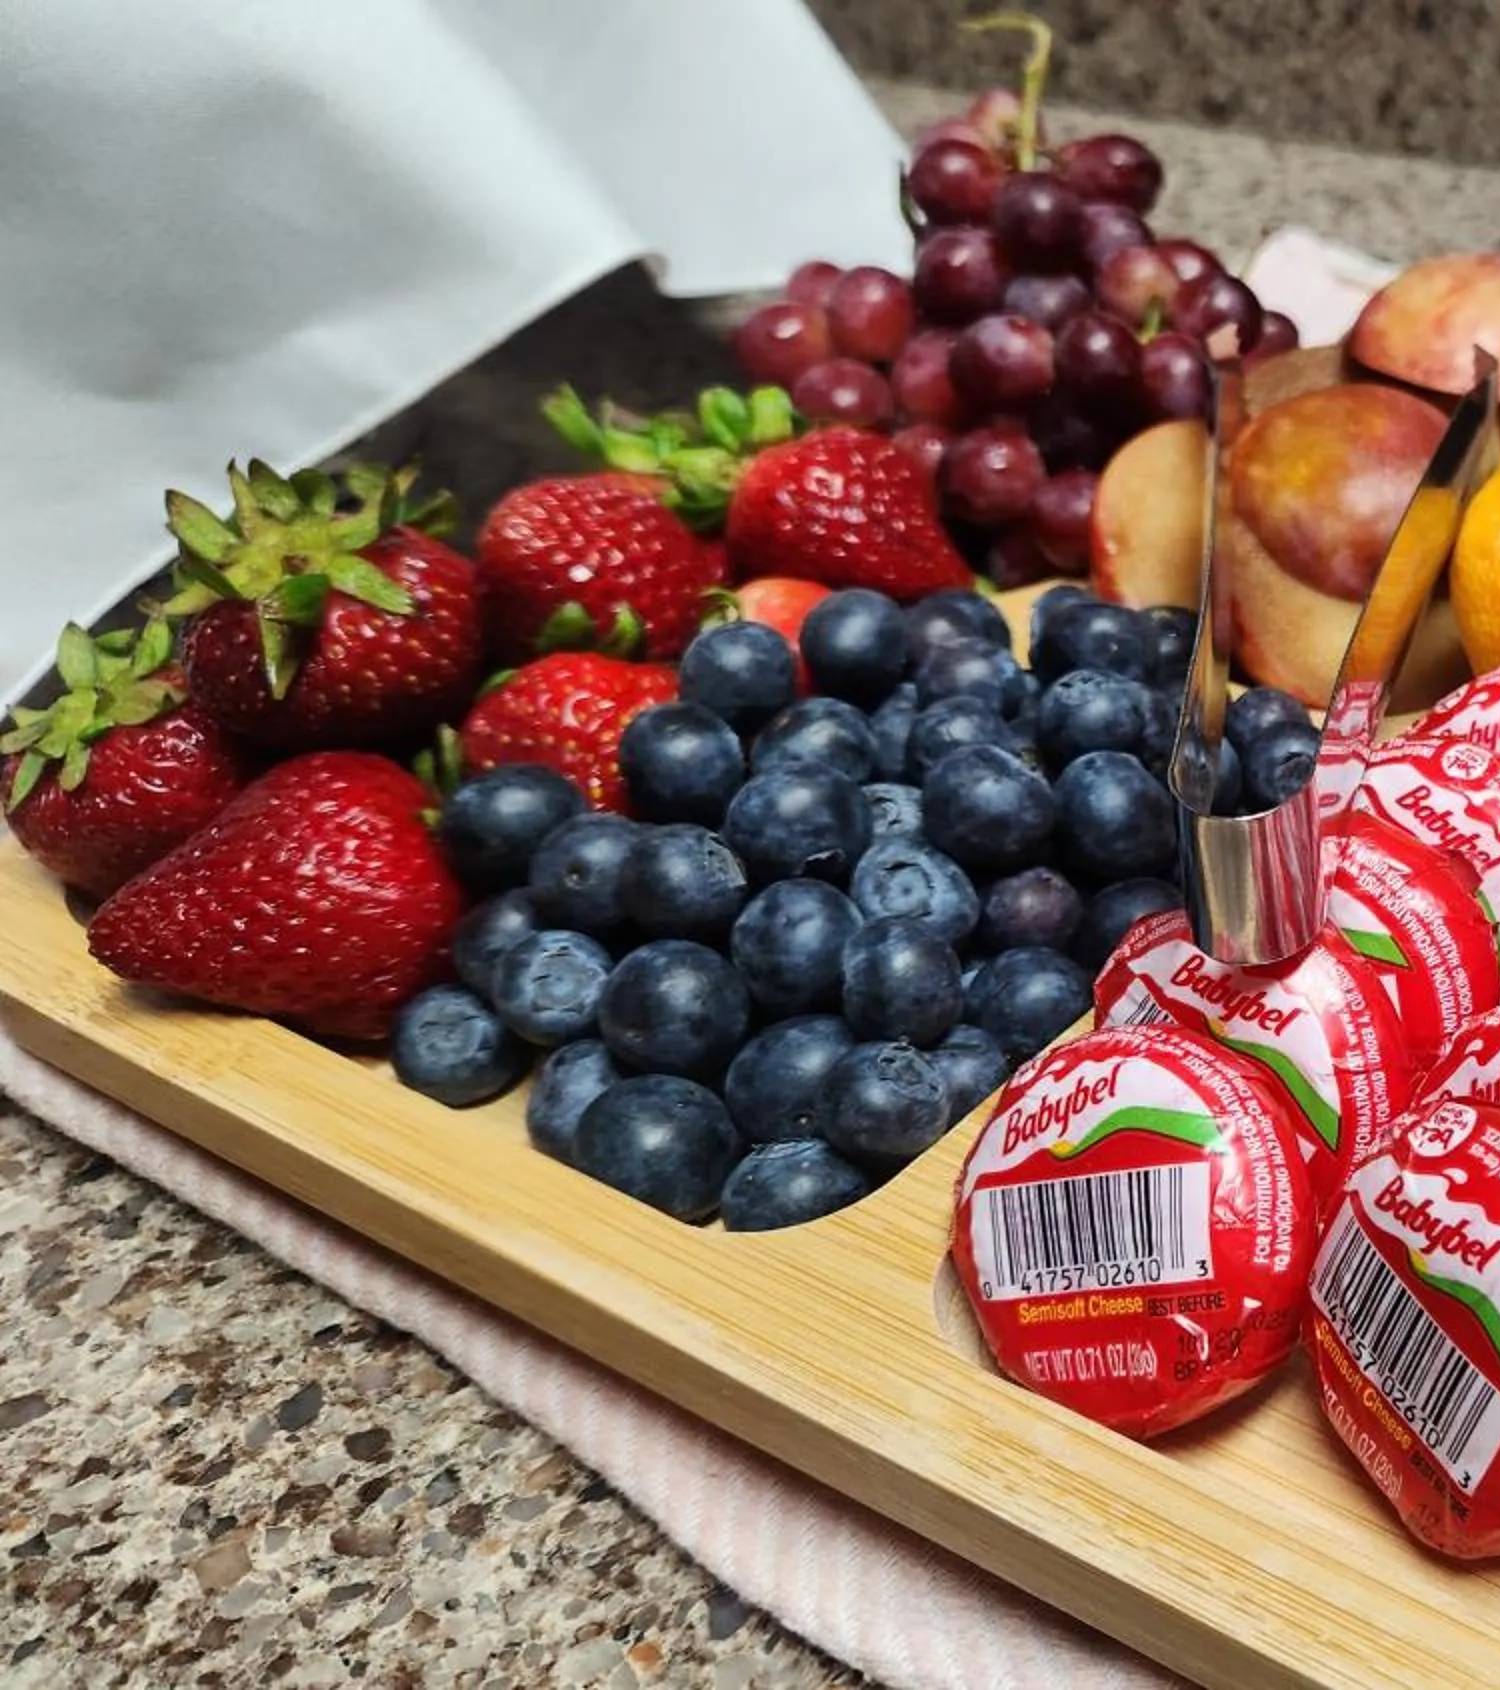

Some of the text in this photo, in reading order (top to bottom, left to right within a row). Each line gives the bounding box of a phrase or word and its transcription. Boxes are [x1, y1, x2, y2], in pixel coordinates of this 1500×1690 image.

[1171, 954, 1302, 1036] Babybel
[1003, 1059, 1121, 1156] Babybel
[1251, 1161, 1271, 1230] NUTRITION
[1253, 1235, 1271, 1263] FOR
[1273, 1254, 1290, 1271] TO
[983, 1258, 1209, 1299] 0 41757 02610 3
[1019, 1298, 1086, 1325] Semisoft
[1088, 1294, 1144, 1318] Cheese
[1330, 1303, 1378, 1371] 41757
[1385, 1375, 1439, 1449] 02610
[1457, 1470, 1471, 1489] 3
